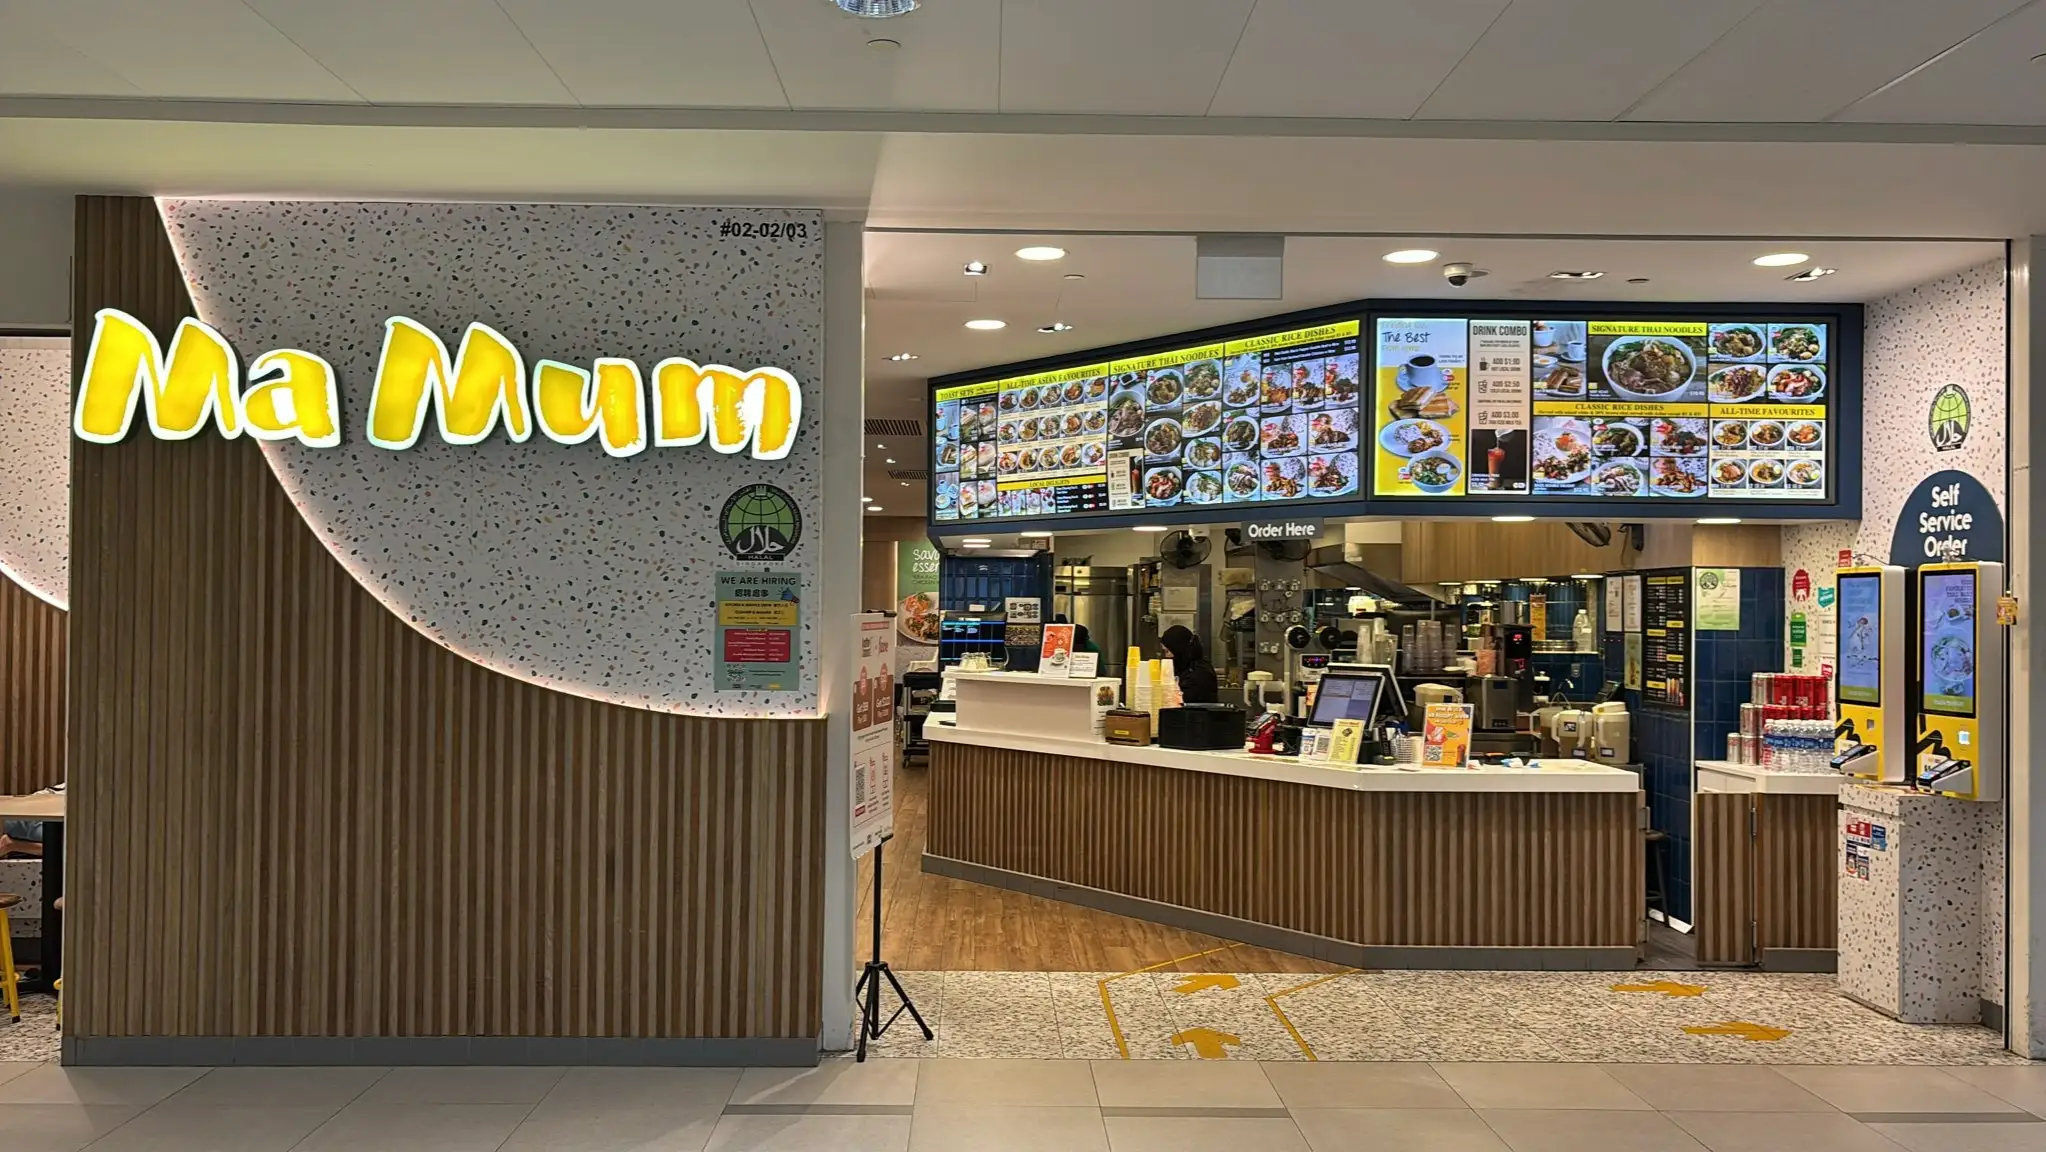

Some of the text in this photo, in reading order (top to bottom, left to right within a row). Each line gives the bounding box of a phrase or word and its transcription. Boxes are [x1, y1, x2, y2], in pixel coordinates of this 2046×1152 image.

[720, 221, 807, 238] #02-02/03
[1244, 335, 1279, 348] CLASSIC
[1281, 331, 1301, 342] RICE
[1304, 326, 1336, 338] DISHES
[1382, 332, 1430, 343] The Best
[1473, 326, 1527, 336] DRINK COMBO
[1592, 325, 1703, 334] SIGNATURE THAI NOODLES
[1113, 360, 1156, 373] SIGNATURE
[1158, 356, 1178, 366] THAI
[1180, 349, 1220, 363] NOODLES
[73, 307, 802, 460] Ma Mum
[1006, 368, 1101, 389] ALL-TIME ASIAN FAVOURITES
[940, 391, 958, 399] TOAST
[959, 388, 974, 396] SETS
[1720, 407, 1815, 416] ALL-TIME FAVOURITES
[1931, 483, 1960, 508] Self
[1919, 509, 1973, 533] Service
[1248, 522, 1316, 538] Order Here
[736, 525, 786, 554] حلال
[721, 576, 797, 586] WE ARE HIRING
